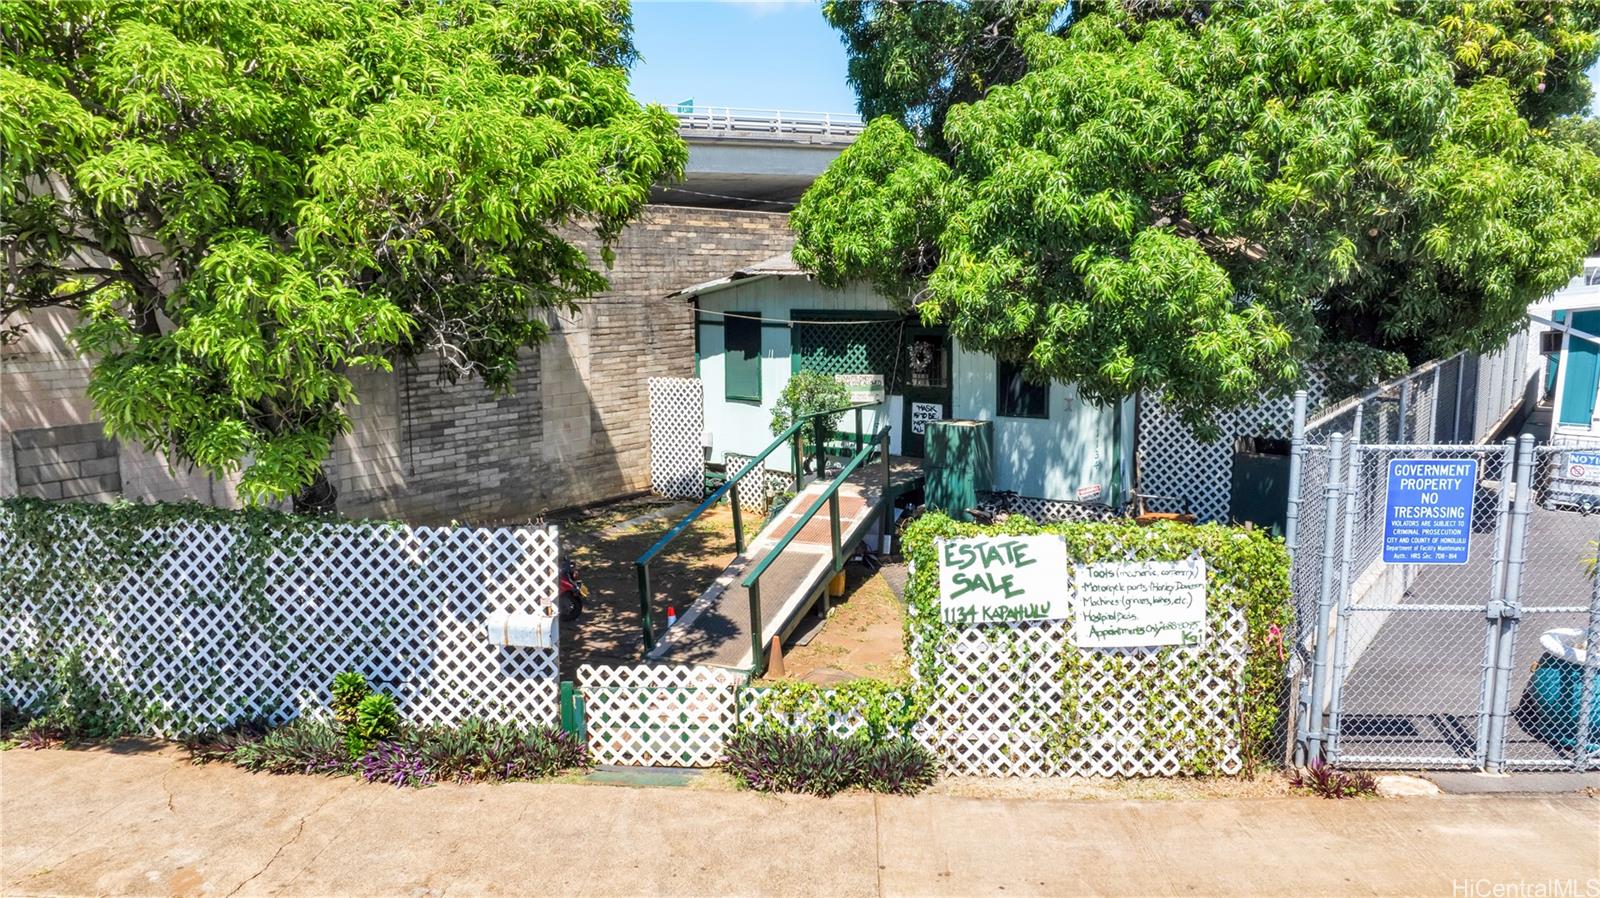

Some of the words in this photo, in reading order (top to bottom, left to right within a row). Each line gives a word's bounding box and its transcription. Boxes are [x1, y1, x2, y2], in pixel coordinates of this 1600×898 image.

[1394, 464, 1471, 476] GOVERNMENT
[1400, 478, 1462, 490] PROPERTY
[1421, 492, 1439, 504] NO
[1394, 506, 1465, 518] TRESPASSING
[944, 541, 1037, 570] ESTATE
[1086, 567, 1115, 578] Tools
[949, 572, 1025, 600] SALE
[944, 604, 979, 623] 1134
[982, 601, 1050, 621] KAPAHULU
[1089, 625, 1146, 641] Appointments
